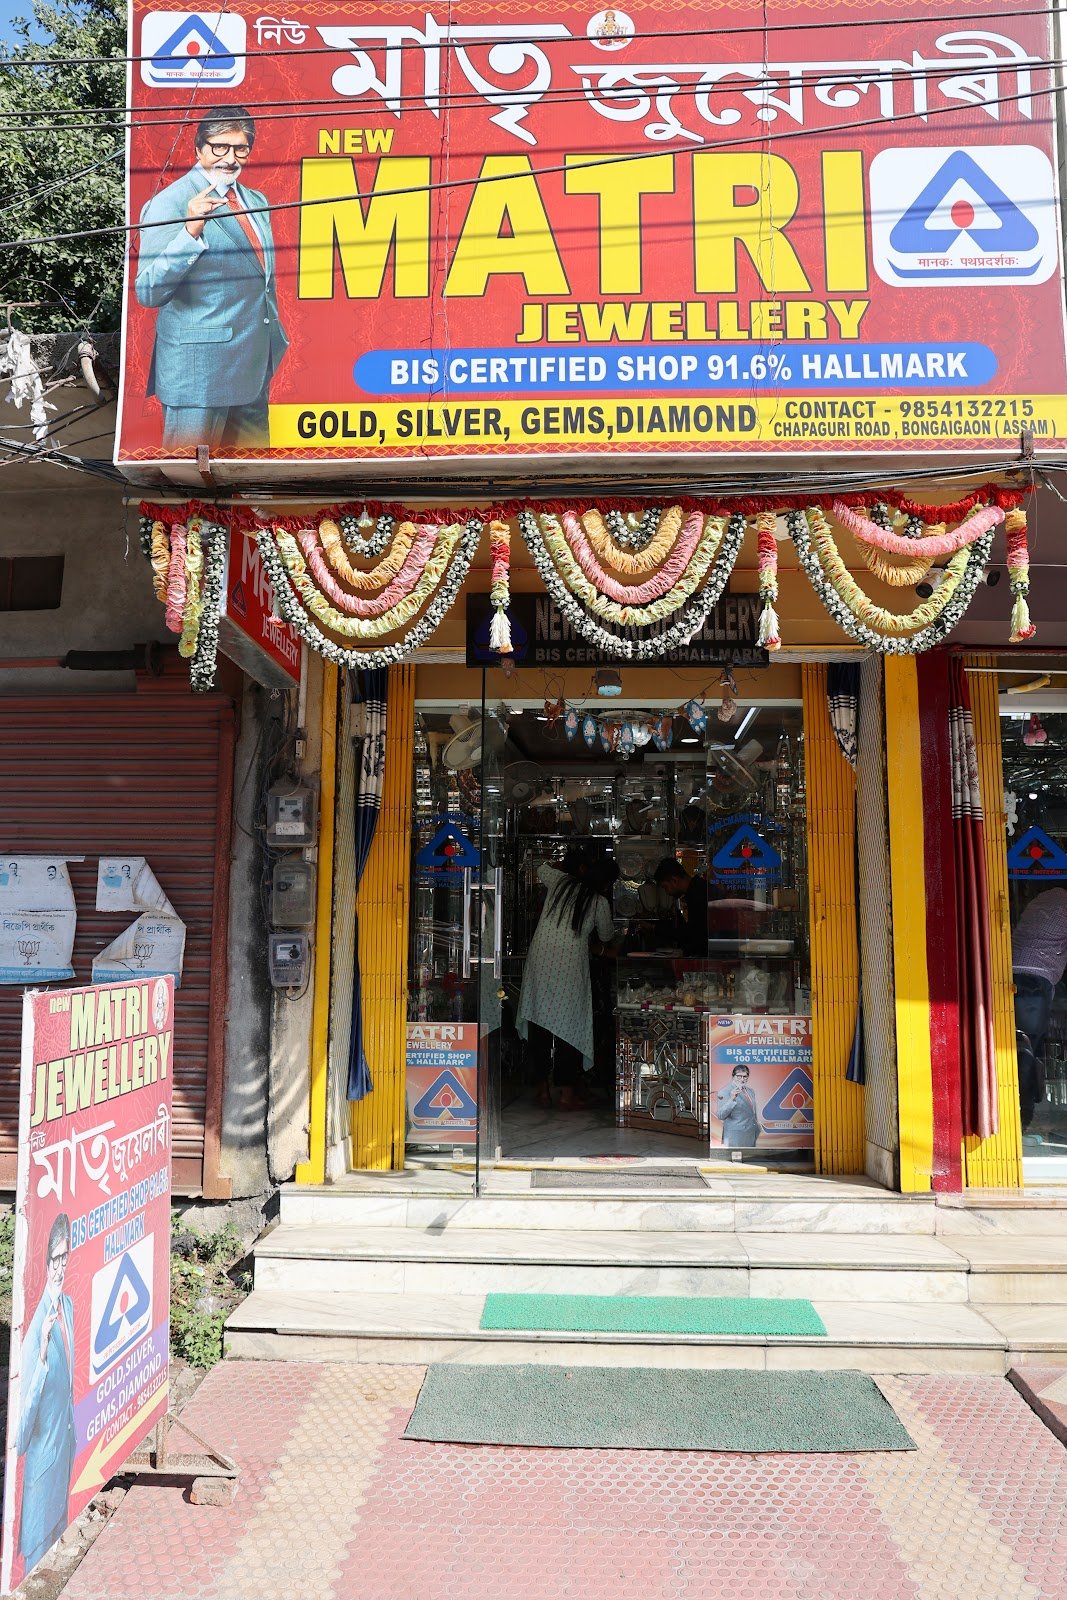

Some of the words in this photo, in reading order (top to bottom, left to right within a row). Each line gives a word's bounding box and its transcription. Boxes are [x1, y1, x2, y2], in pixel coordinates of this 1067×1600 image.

[253, 17, 310, 46] নিউ
[315, 12, 571, 145] মাতৃ
[317, 129, 394, 154] NEW
[297, 150, 869, 300] MATRI
[515, 300, 870, 344] JEWELLERY
[390, 359, 439, 386] BIS
[449, 356, 608, 384] CERTIFIED
[616, 355, 698, 380] SHOP
[707, 355, 792, 381] 91.6%
[802, 352, 968, 379] HALLMARK
[297, 409, 386, 444] GOLD,
[396, 407, 511, 441] SILVER,
[784, 401, 877, 419] CONTACT
[899, 399, 1034, 417] 9854132215
[773, 421, 850, 437] CHAPAGURI
[902, 419, 991, 436] BONGAIGAON
[535, 648, 561, 662] BIS
[70, 984, 149, 1051] MATRI
[406, 1026, 464, 1040] ATRI
[406, 1041, 453, 1050] EWELLERY
[746, 1036, 804, 1045] JEWELLERY
[31, 1031, 171, 1128] JEWELLERY
[416, 1058, 464, 1066] HALLMARK
[32, 1120, 116, 1204] মাতৃ
[71, 1214, 87, 1252] BIS
[88, 1190, 129, 1240] CERTIFIED
[130, 1178, 149, 1214] SHOP
[104, 1210, 145, 1264] HALLMARK
[106, 1402, 133, 1442] CONTACT
